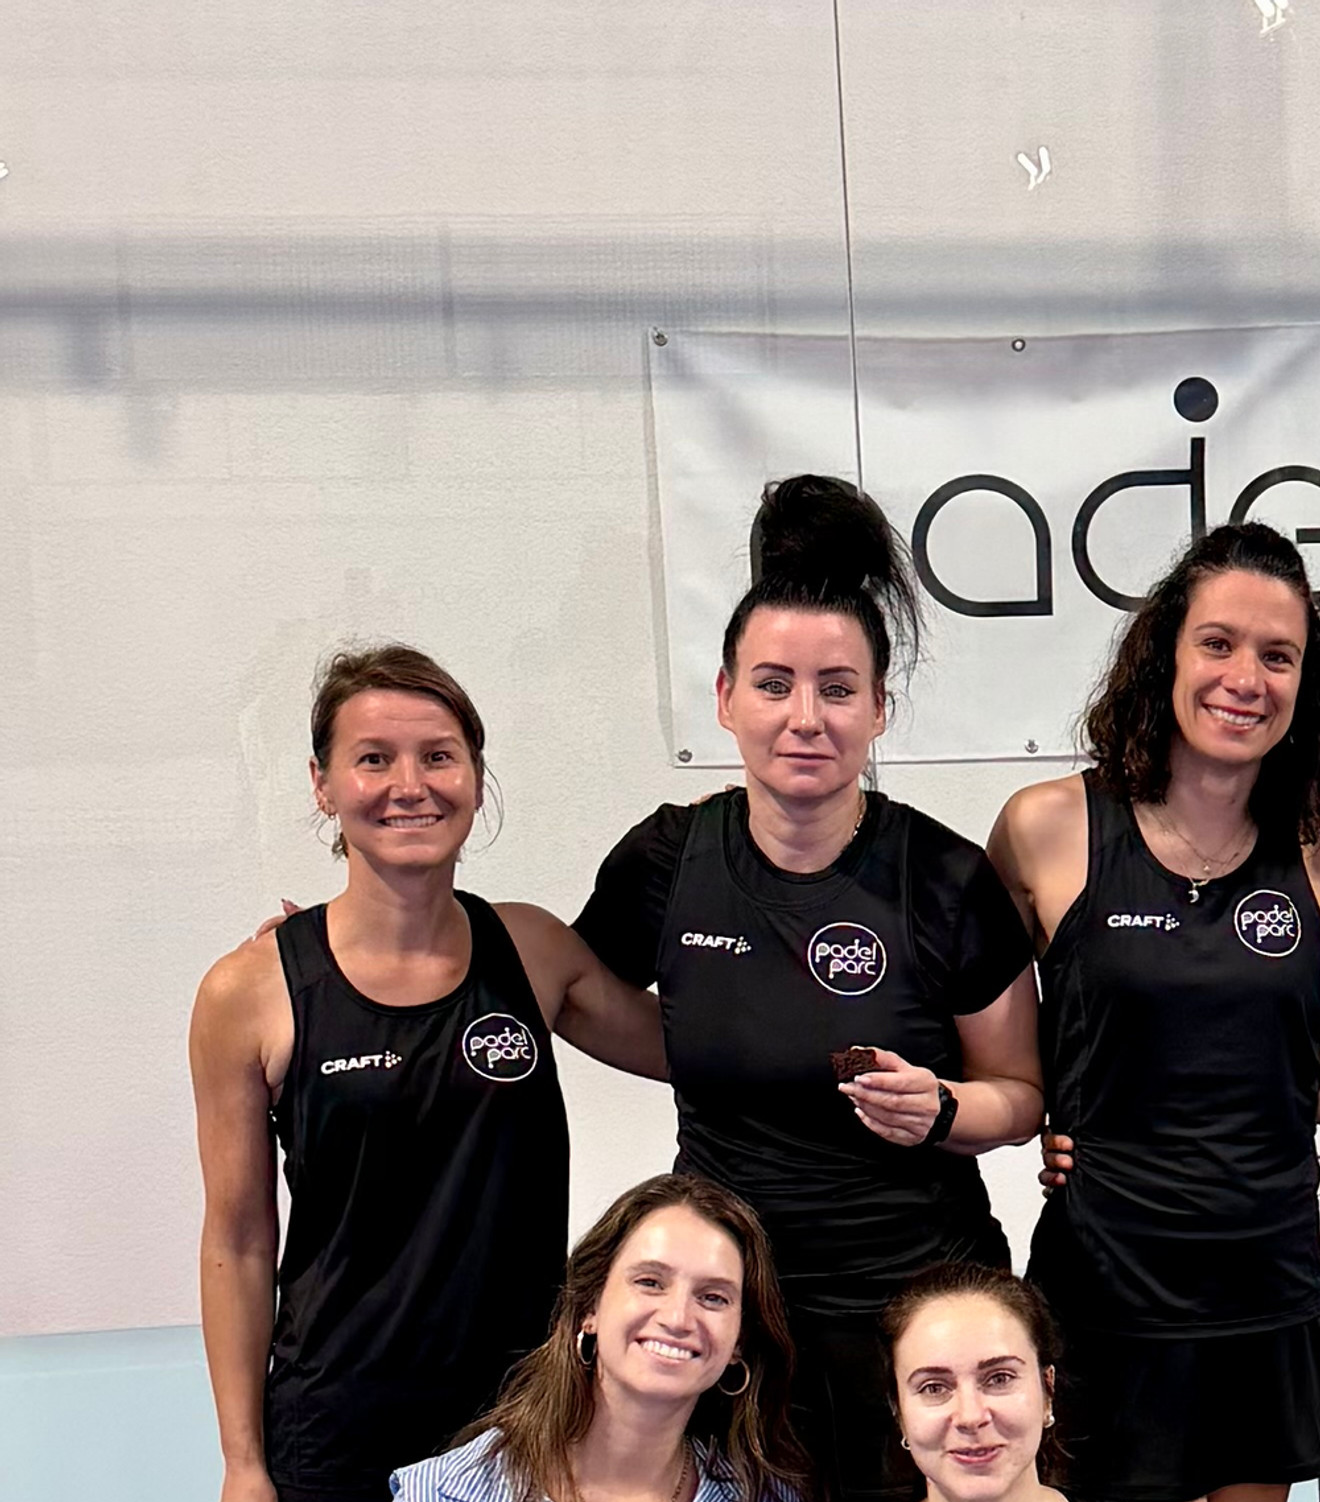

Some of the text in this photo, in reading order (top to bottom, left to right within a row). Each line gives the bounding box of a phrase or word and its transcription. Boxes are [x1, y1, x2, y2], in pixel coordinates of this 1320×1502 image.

[1107, 914, 1165, 928] CRAFT
[1241, 904, 1294, 931] padel
[681, 932, 736, 950] CRAFT
[1256, 924, 1296, 944] parc
[815, 938, 877, 963] padel
[828, 958, 876, 980] parc
[470, 1026, 528, 1057] padel
[320, 1054, 384, 1075] CRAFT
[487, 1046, 531, 1069] parc
